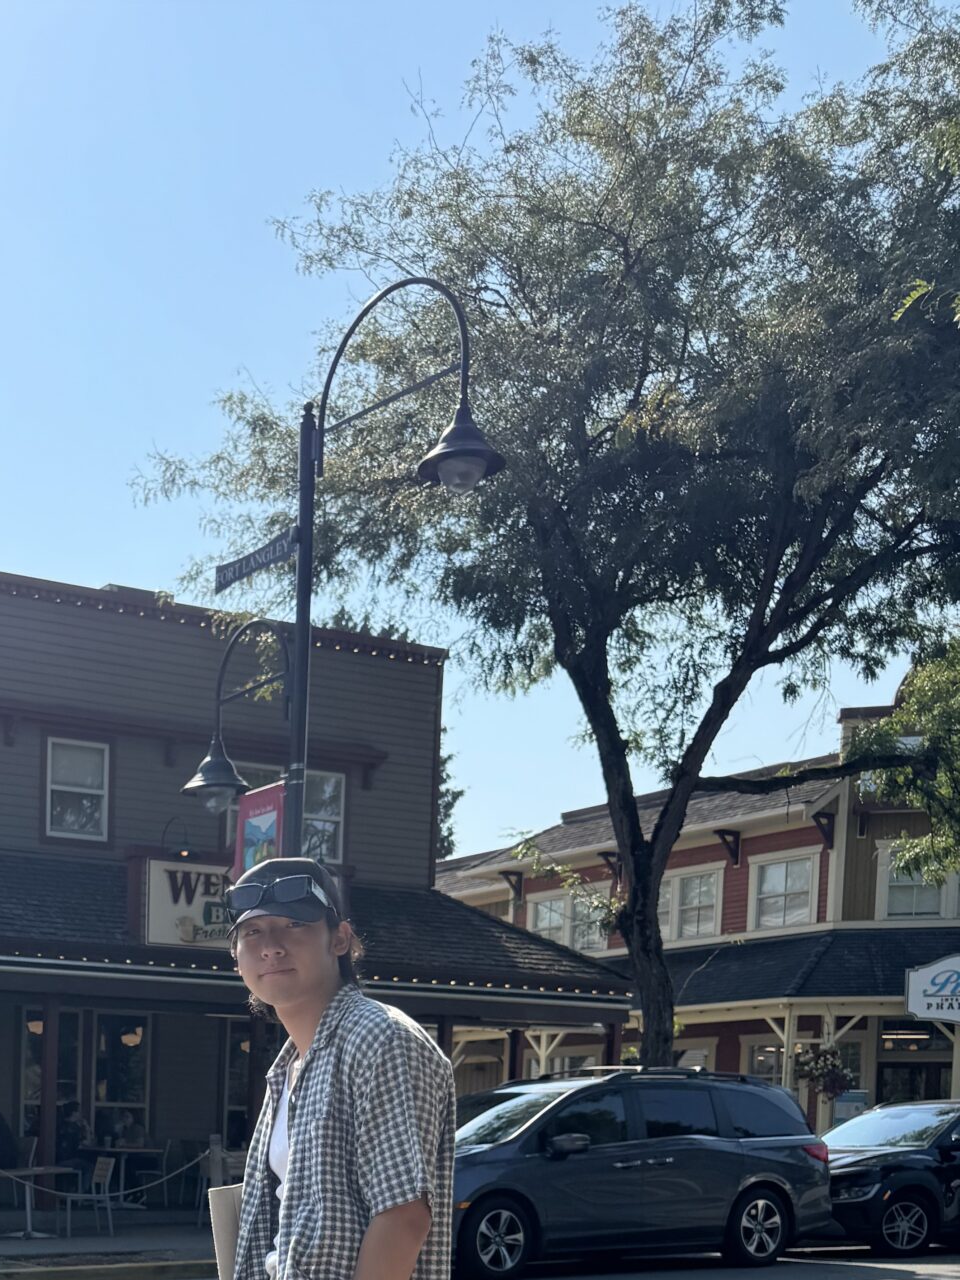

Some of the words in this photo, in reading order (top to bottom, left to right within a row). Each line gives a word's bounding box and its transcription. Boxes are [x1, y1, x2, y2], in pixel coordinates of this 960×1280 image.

[216, 563, 241, 587] FORT
[242, 537, 289, 574] LANGLEY
[926, 1002, 960, 1010] PHA
